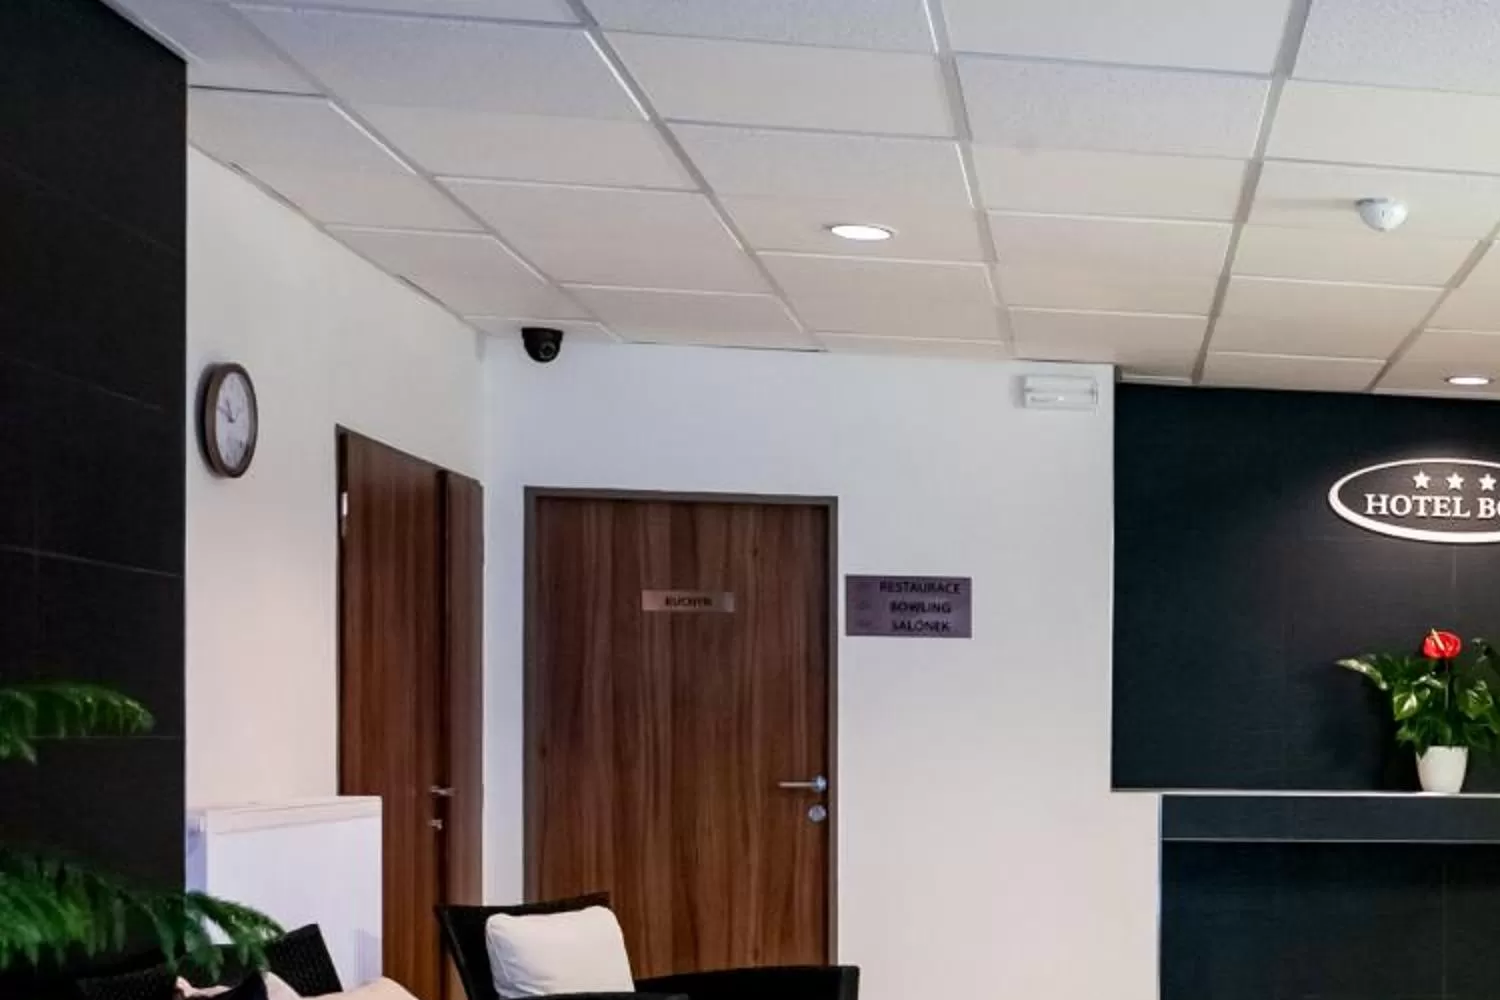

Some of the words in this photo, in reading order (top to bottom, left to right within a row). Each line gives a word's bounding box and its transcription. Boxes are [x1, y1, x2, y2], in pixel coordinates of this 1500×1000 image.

[1364, 493, 1471, 519] HOTEL
[879, 581, 961, 594] RESTAURACE
[890, 600, 952, 613] BOWLING
